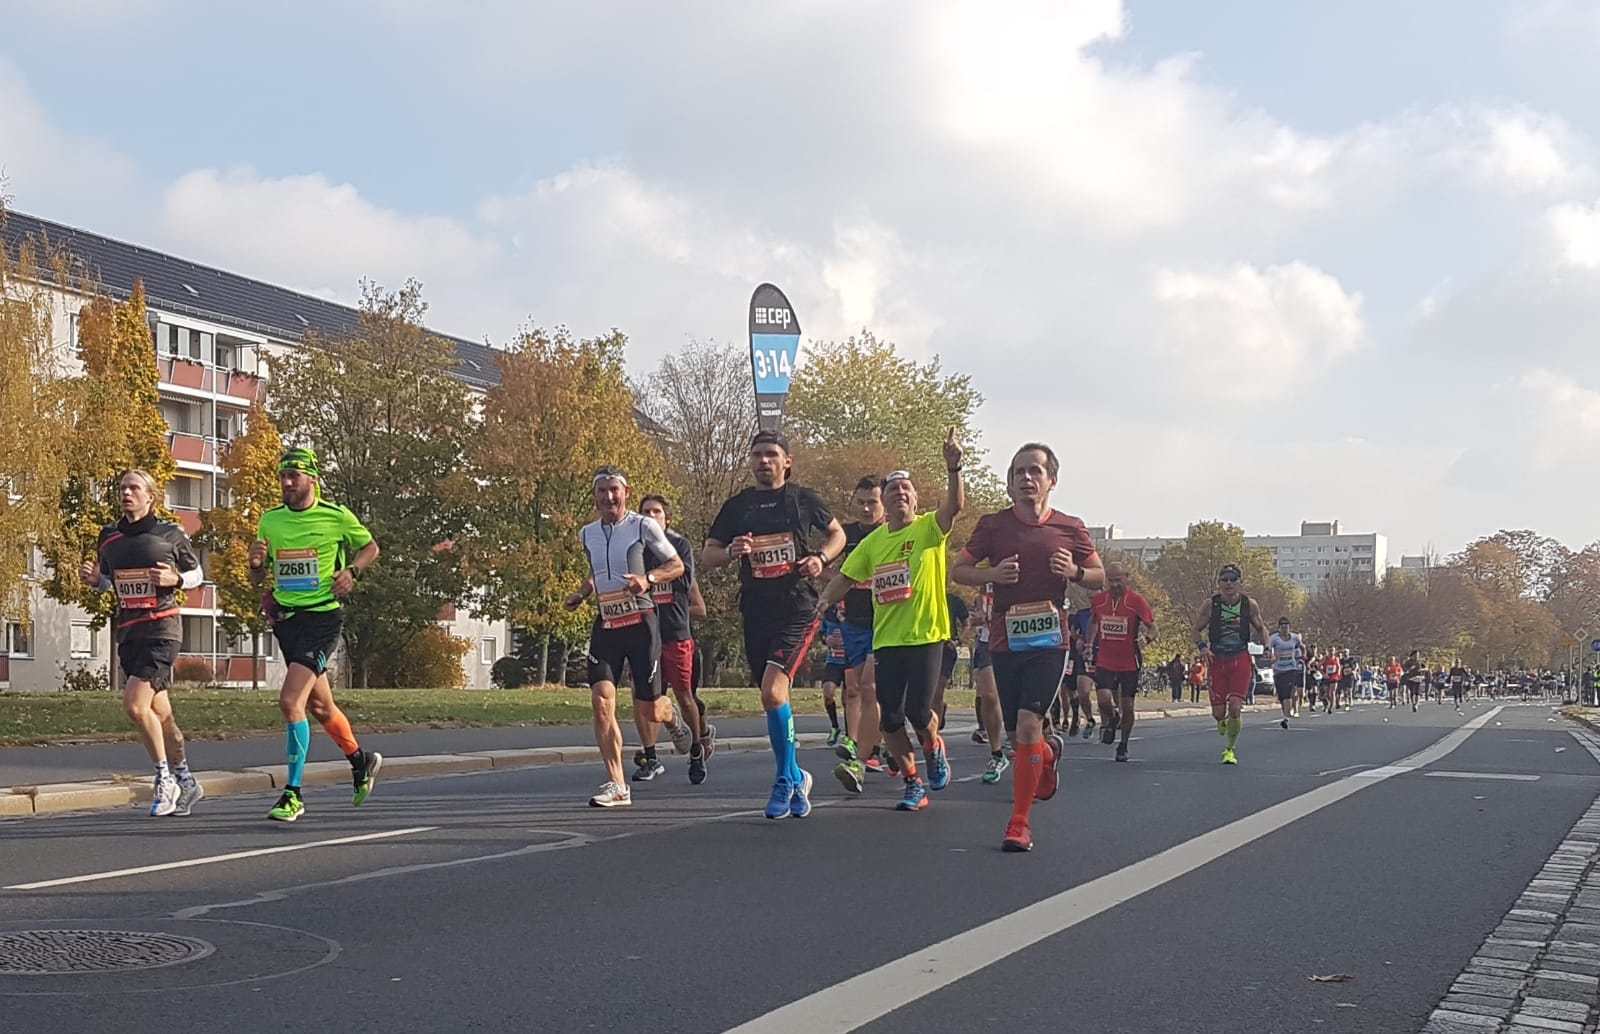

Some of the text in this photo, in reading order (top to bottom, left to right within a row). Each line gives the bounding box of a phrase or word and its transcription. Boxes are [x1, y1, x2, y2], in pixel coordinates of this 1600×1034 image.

[768, 308, 791, 330] cep
[754, 349, 792, 379] 3:14
[753, 548, 789, 564] 40315
[279, 562, 311, 576] 22681
[119, 582, 149, 595] 40187
[875, 573, 905, 590] 40424
[603, 601, 632, 616] 40213
[1012, 616, 1053, 634] 20439
